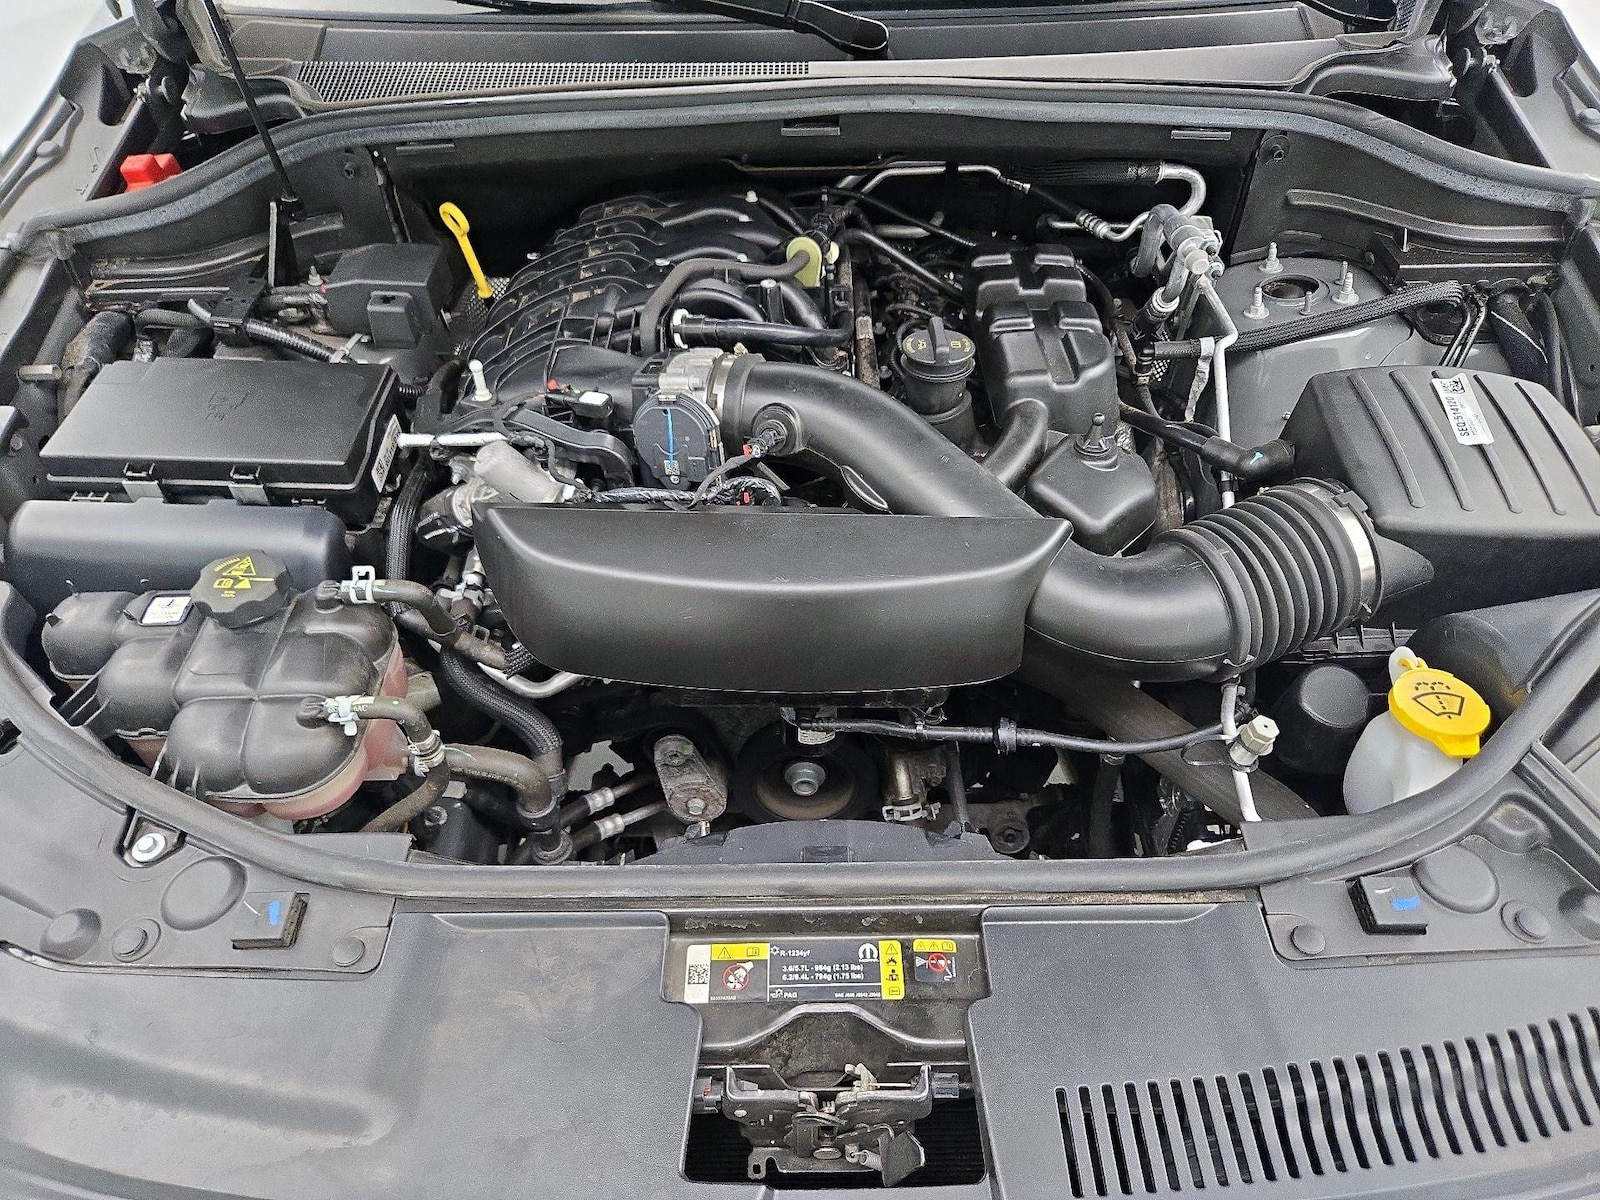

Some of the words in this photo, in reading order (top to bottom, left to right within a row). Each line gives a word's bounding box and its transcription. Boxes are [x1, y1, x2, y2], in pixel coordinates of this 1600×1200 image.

[1445, 396, 1470, 437] SEQ:514120
[780, 949, 811, 958] R-1234yf
[833, 963, 850, 972] (2.13
[833, 972, 850, 981] (1.75
